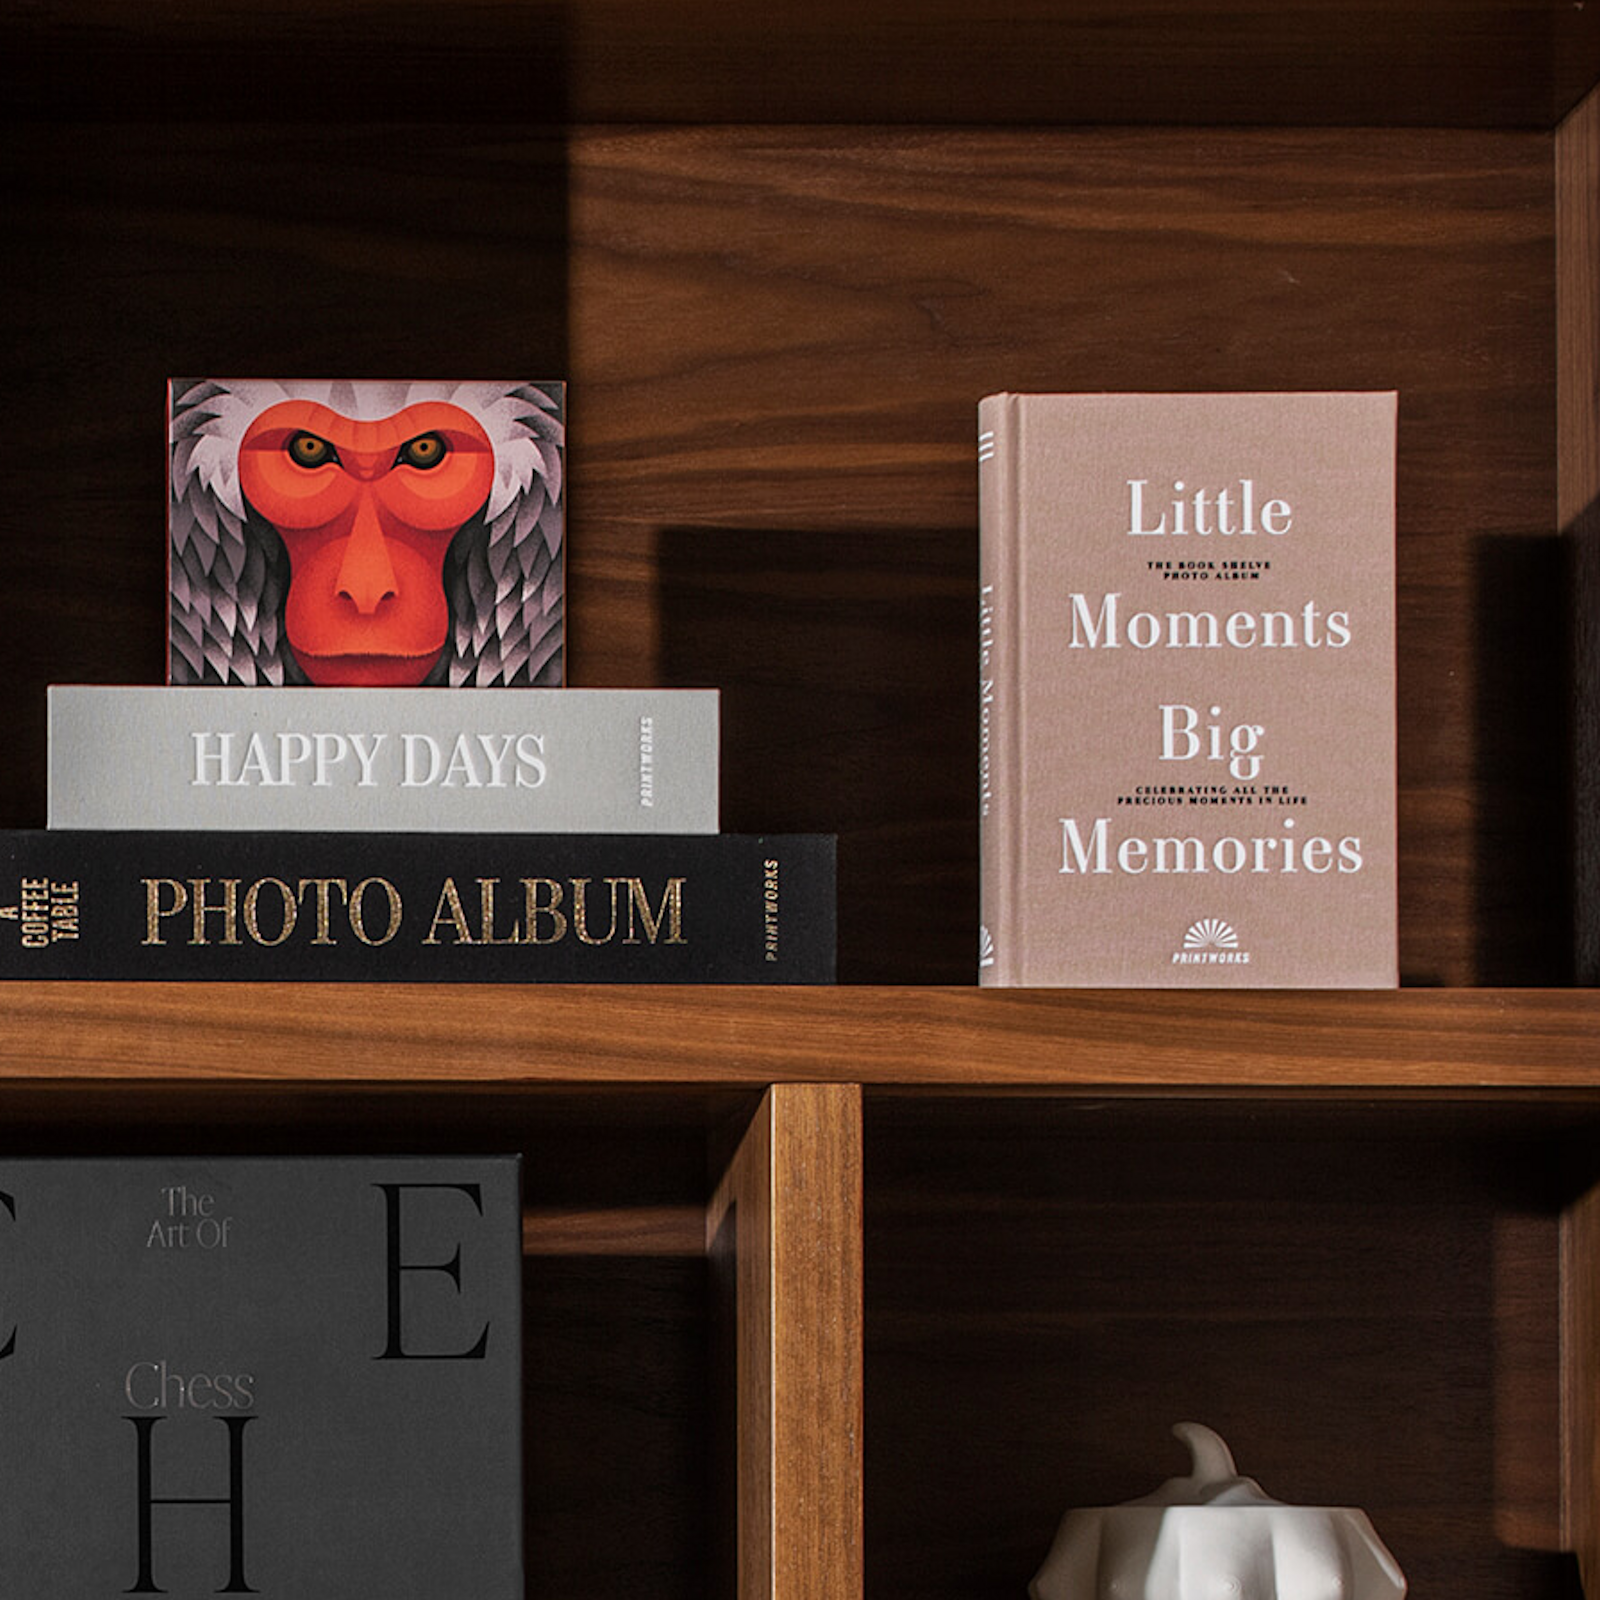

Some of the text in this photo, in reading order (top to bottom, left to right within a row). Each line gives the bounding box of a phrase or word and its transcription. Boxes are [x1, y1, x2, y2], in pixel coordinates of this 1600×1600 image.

[1126, 479, 1293, 536] Little
[1147, 561, 1271, 570] THE BOOK SHELVE
[1163, 572, 1260, 580] PHOTO ALBUM
[1068, 593, 1352, 649] Moments
[191, 732, 548, 789] HAPPY DAYS
[640, 716, 653, 807] PRINTWORKS
[1159, 705, 1266, 780] Big
[1117, 796, 1308, 805] PRECIOUS MOMENTS IN LIFE
[1135, 786, 1289, 795] CELEBRATING ALL THE
[1059, 818, 1364, 875] Memories
[21, 877, 49, 948] COFFEE
[50, 880, 79, 943] TABLE
[139, 876, 688, 948] PHOTO ALBUM
[763, 859, 778, 962] PRINTWORKS
[1172, 952, 1250, 965] PRINTWORKS
[160, 1186, 215, 1217] The
[146, 1216, 234, 1250] Art Of
[370, 1183, 490, 1360] E
[124, 1361, 256, 1409] Chess
[121, 1416, 260, 1593] H
